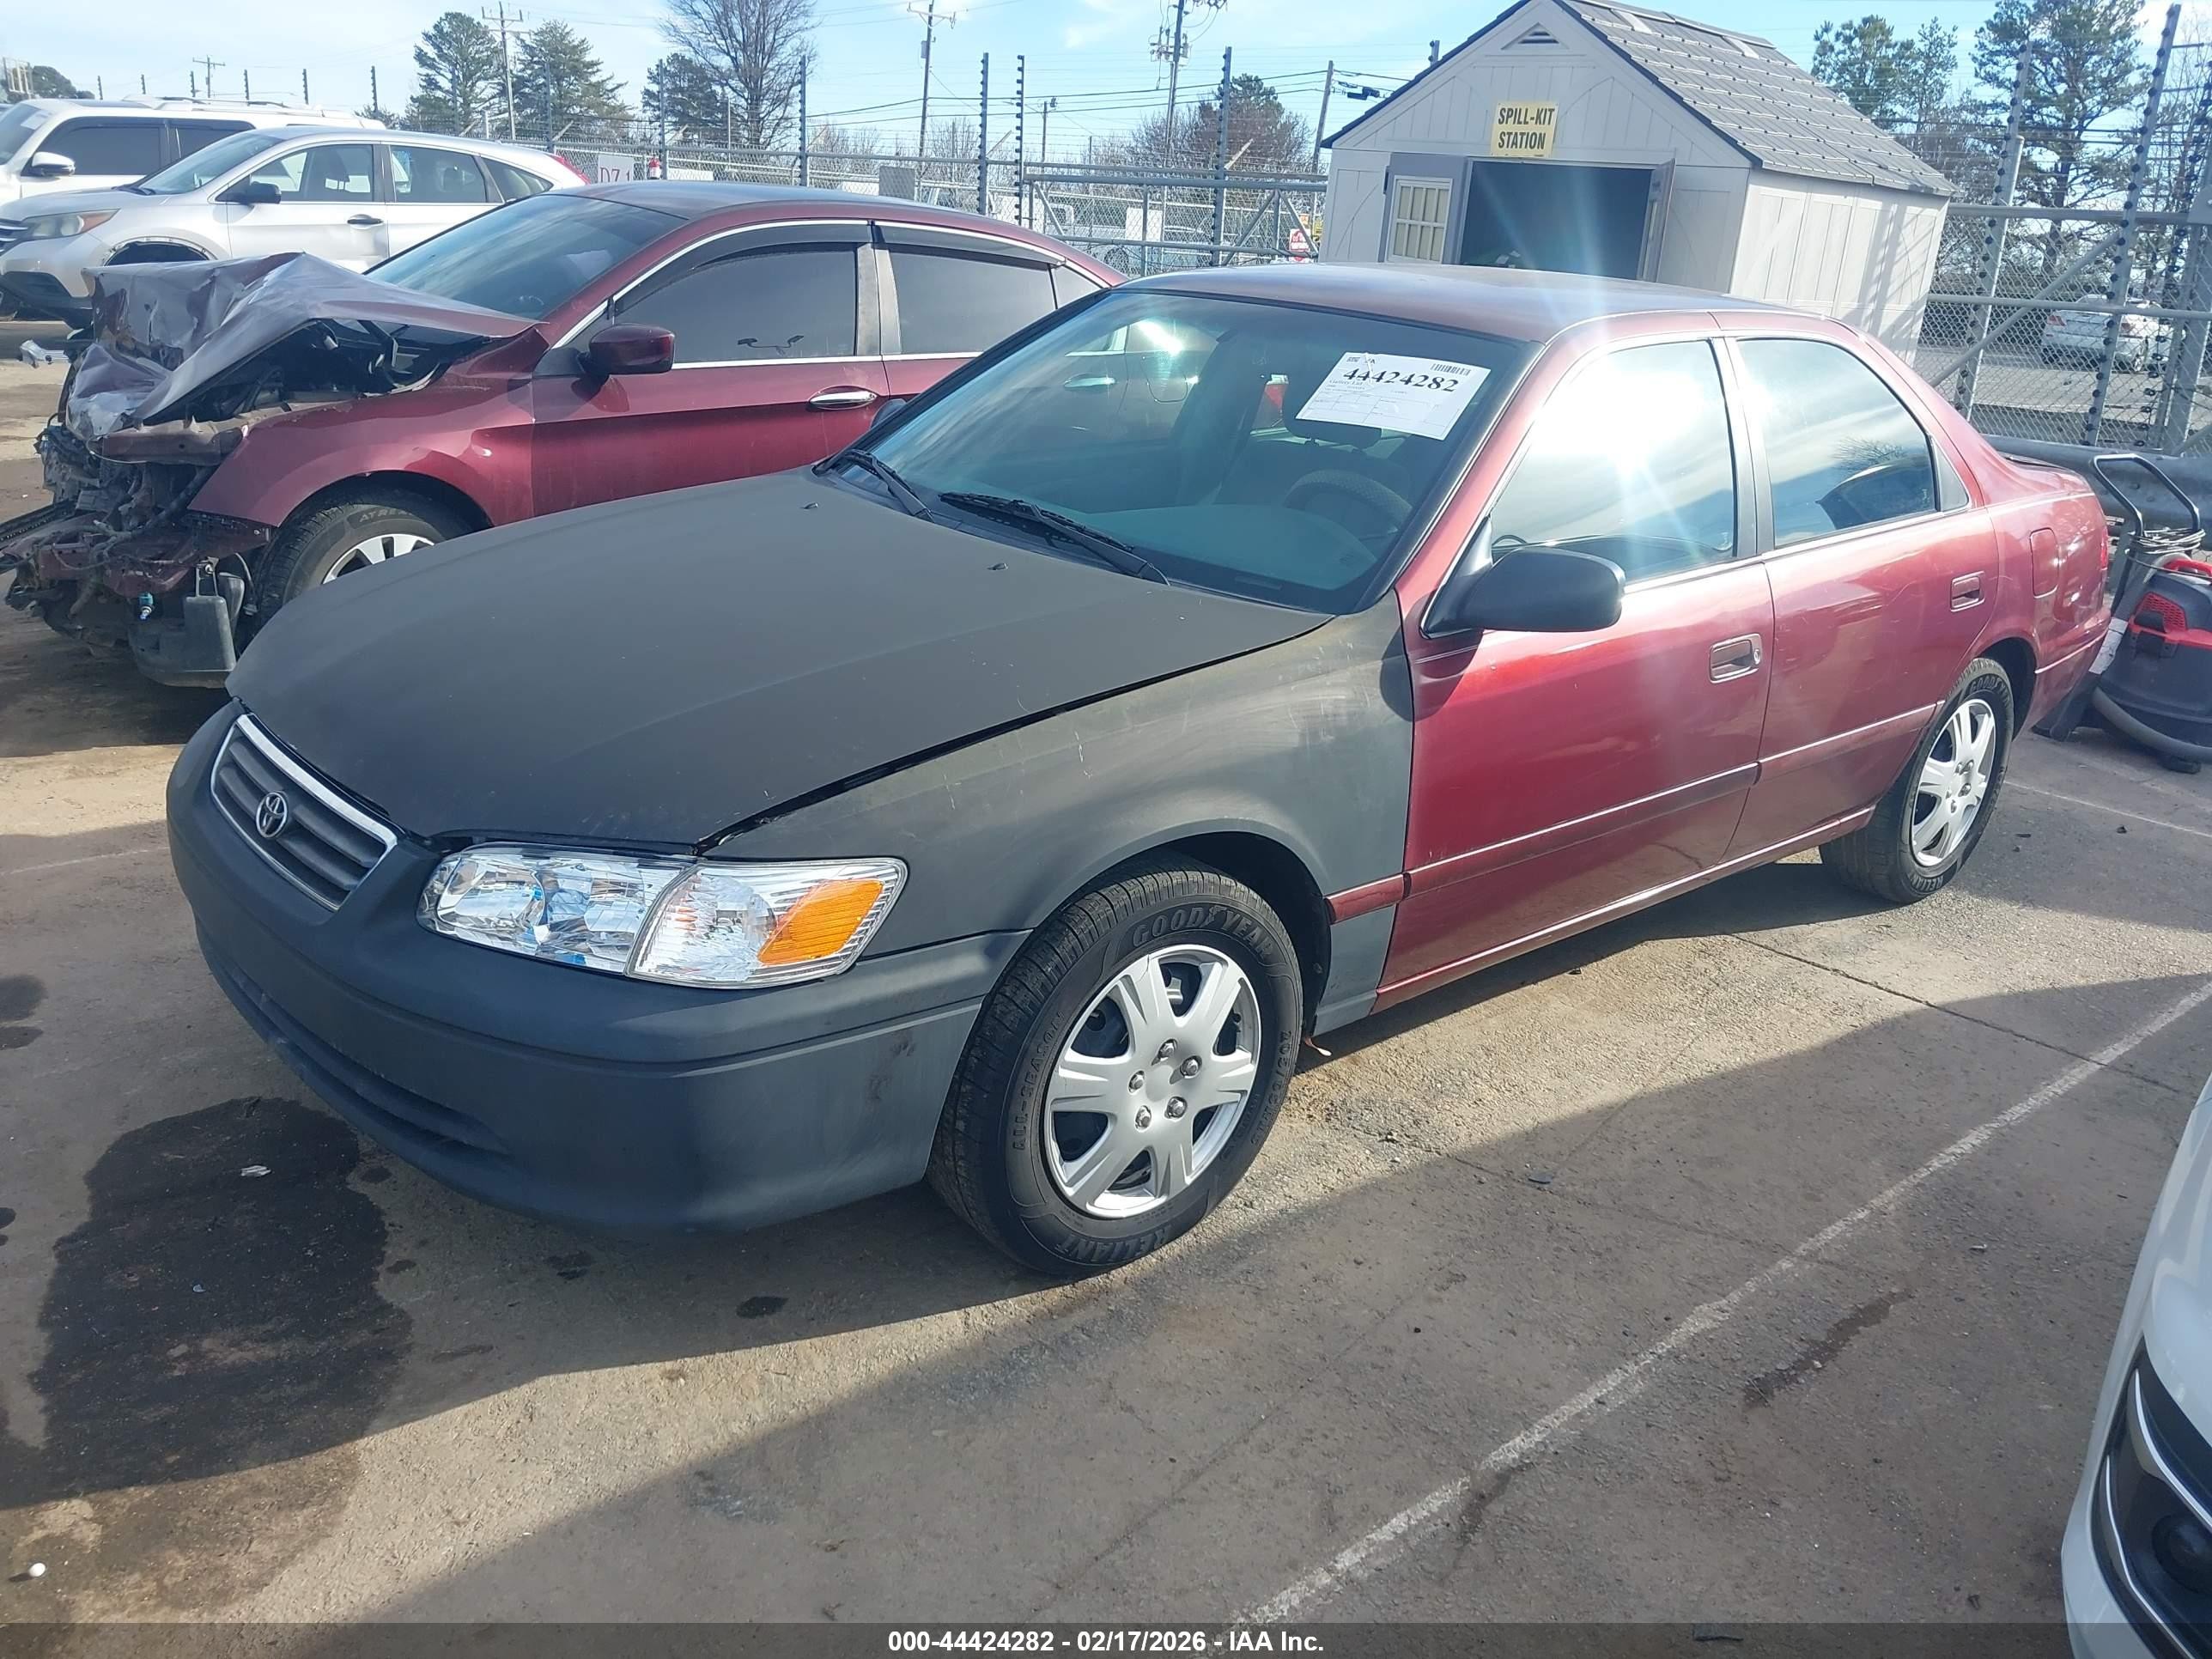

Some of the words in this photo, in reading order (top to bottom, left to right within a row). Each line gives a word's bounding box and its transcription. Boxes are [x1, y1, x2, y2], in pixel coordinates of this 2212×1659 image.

[1498, 107, 1555, 126] SPILL-KIT
[1498, 131, 1547, 150] STATION
[1343, 368, 1460, 393] 44424282
[1133, 904, 1274, 960] GOODYEAR
[1012, 1010, 1066, 1151] ALL-SEASON
